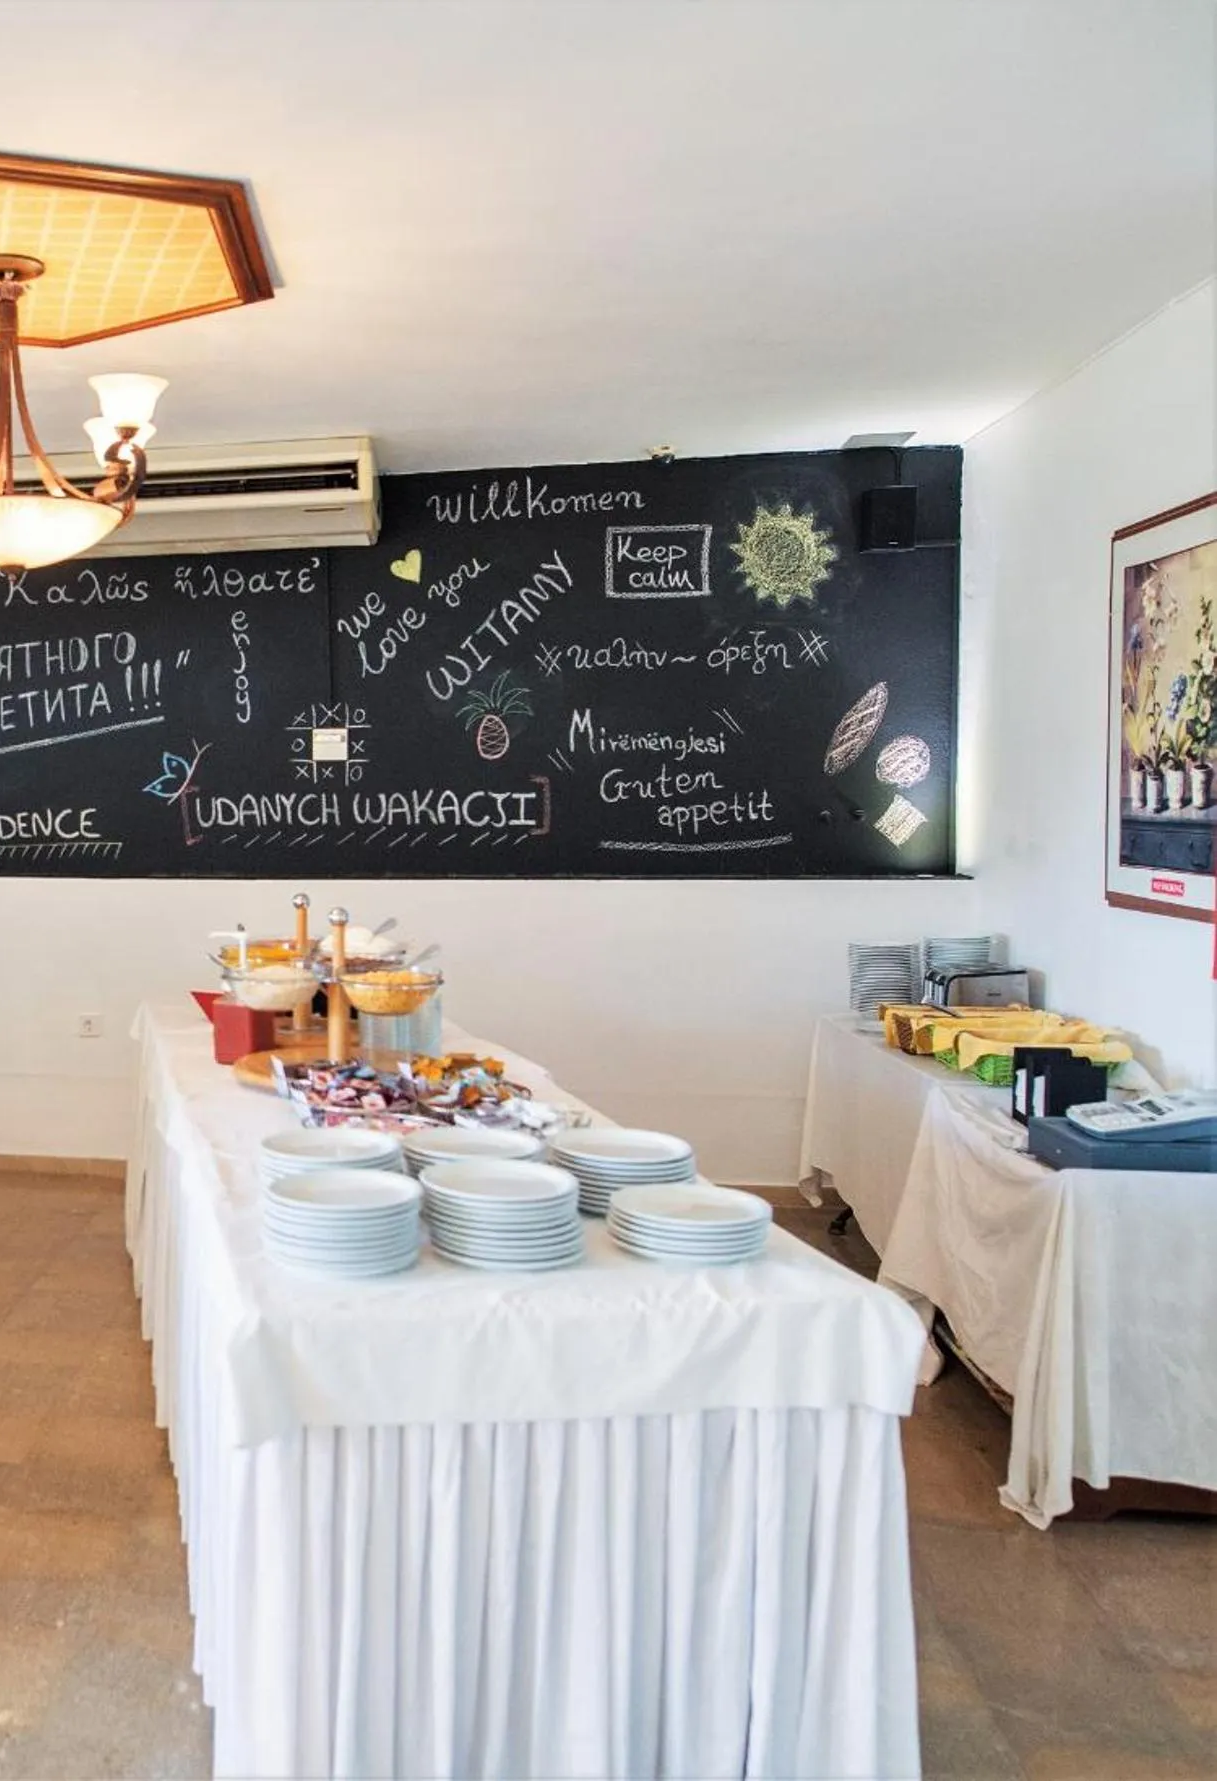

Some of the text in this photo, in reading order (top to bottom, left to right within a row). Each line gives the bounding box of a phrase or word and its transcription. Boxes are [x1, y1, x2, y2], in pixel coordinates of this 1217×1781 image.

[617, 535, 687, 569] Keep
[427, 558, 491, 608] you
[629, 567, 696, 590] calm
[426, 549, 573, 700] WITAMY
[599, 763, 724, 803] Guten
[195, 789, 537, 829] UDANYCH WAKACJI
[657, 788, 775, 836] appetit
